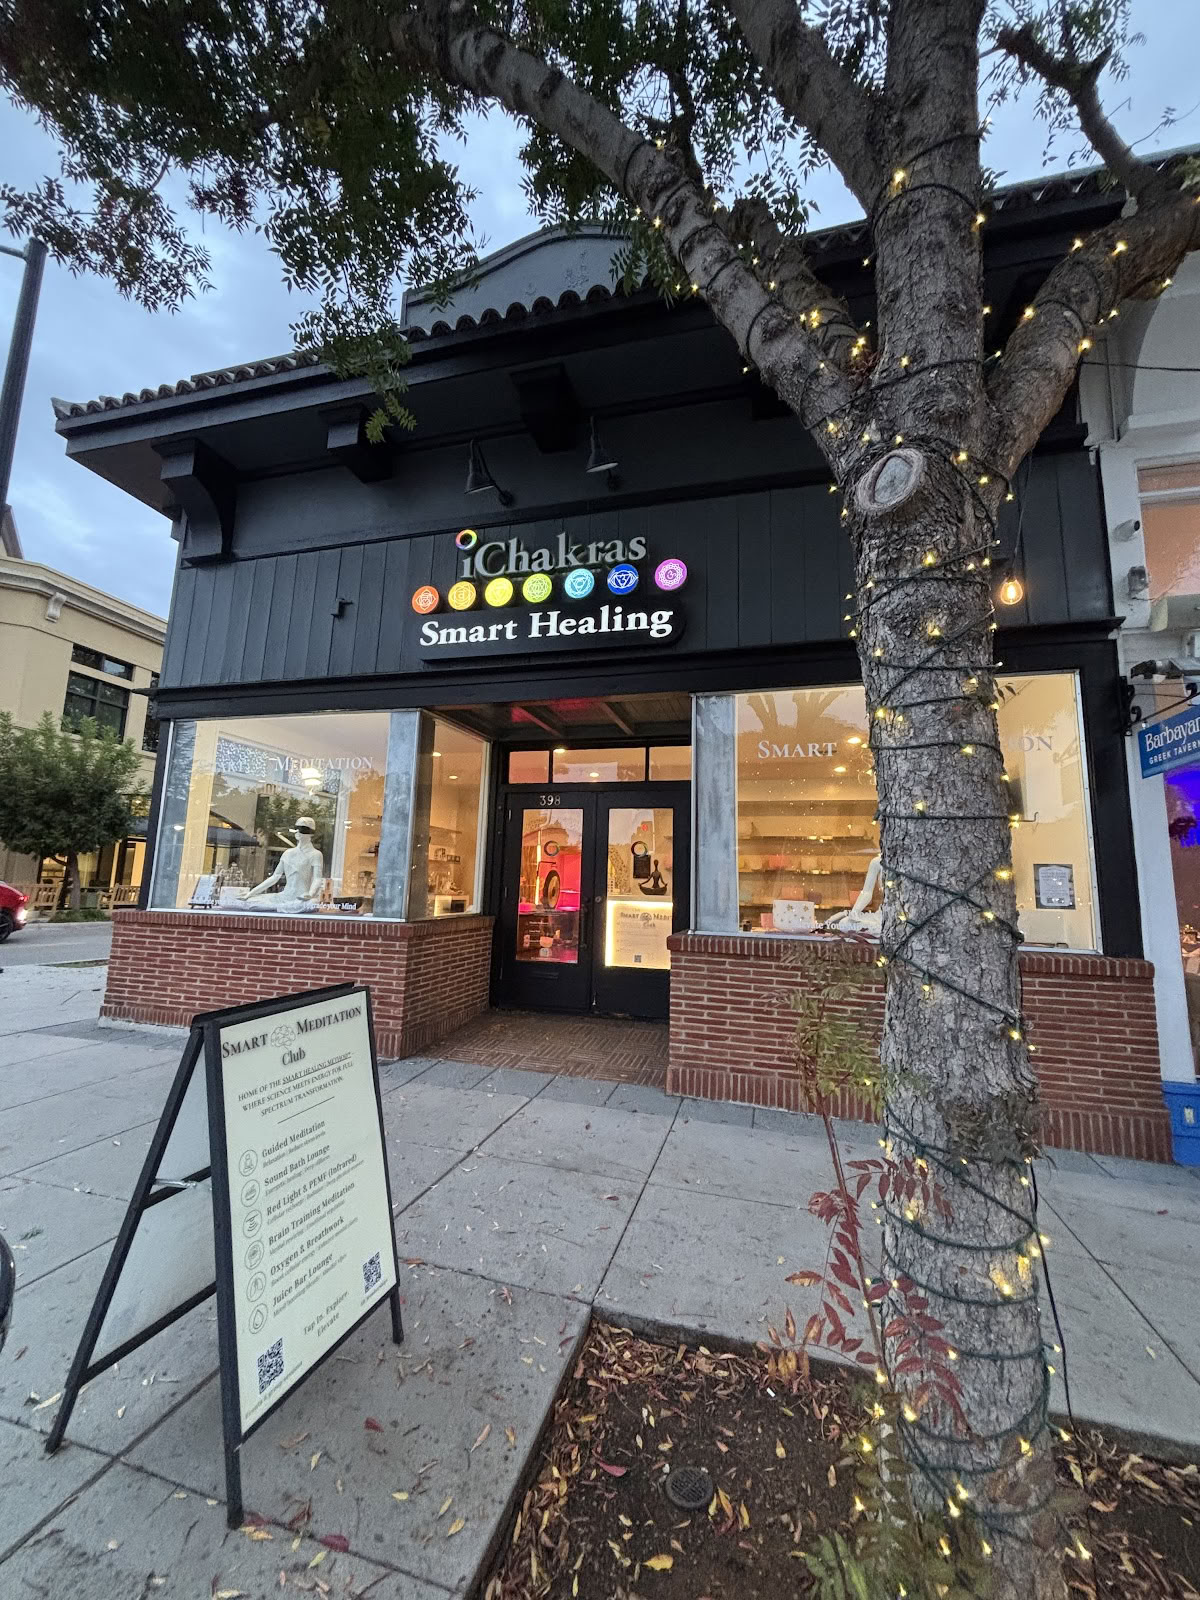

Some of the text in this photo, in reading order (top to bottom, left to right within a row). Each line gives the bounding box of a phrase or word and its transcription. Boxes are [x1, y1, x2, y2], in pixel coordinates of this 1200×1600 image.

[455, 528, 647, 578] iChakras
[420, 604, 674, 647] Smart Healing
[275, 756, 374, 772] MEDITATION
[757, 740, 838, 759] SMART
[1148, 750, 1172, 765] GREEK
[539, 794, 561, 806] 398
[341, 902, 357, 910] Mind
[222, 1006, 361, 1059] SMART MEDITATION
[282, 1047, 306, 1066] Club
[238, 1088, 258, 1101] HOME
[259, 1084, 268, 1093] OF
[269, 1079, 281, 1089] THE
[282, 1071, 302, 1084] SMART
[303, 1061, 327, 1075] HEALING
[242, 1097, 265, 1111] WHERE
[267, 1086, 291, 1102] SCIENCE
[292, 1079, 311, 1090] MEETS
[311, 1070, 331, 1083] ENERGY
[332, 1066, 342, 1075] FOR
[261, 1076, 343, 1117] SPECTRUM TRANSFORMATION
[262, 1137, 288, 1158] Guided
[289, 1121, 325, 1143] Meditation
[264, 1166, 288, 1186] Sound
[289, 1157, 306, 1172] Bath
[307, 1145, 330, 1163] Lounge
[267, 1199, 281, 1216] Red
[283, 1188, 301, 1206] Light
[303, 1184, 308, 1193] &
[309, 1172, 326, 1189] PEMF
[328, 1153, 357, 1178] (Infrared)
[268, 1227, 290, 1246] Brain
[291, 1205, 321, 1230] Training
[322, 1182, 355, 1208] Meditation
[270, 1250, 299, 1276] Oxygen
[300, 1244, 305, 1254] &
[306, 1216, 344, 1249] Breathwork
[273, 1253, 333, 1307] Juice Bar Lounge
[304, 1321, 316, 1335] Tap
